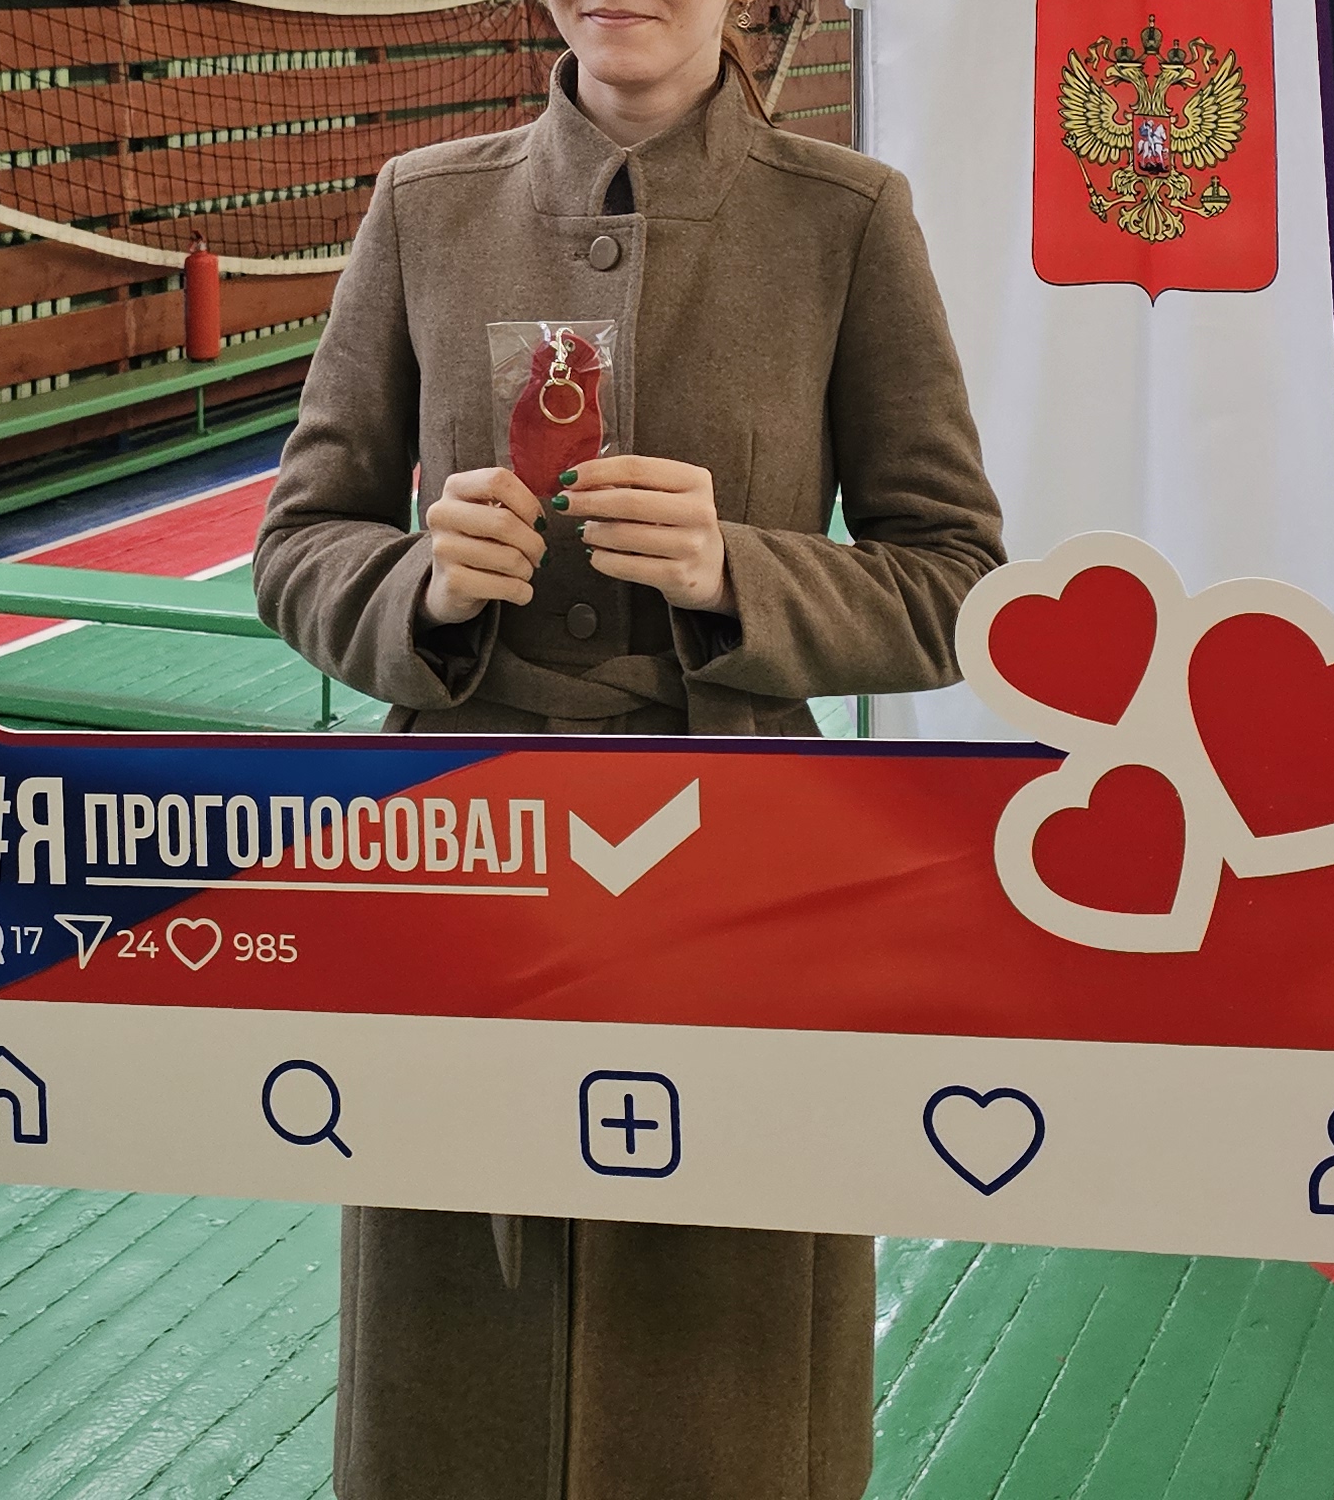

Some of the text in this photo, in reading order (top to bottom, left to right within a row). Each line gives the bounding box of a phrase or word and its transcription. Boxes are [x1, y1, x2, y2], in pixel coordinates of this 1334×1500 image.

[84, 793, 547, 874] ПРОГОЛОСОВАЛ
[10, 926, 298, 963] 17 24 985
